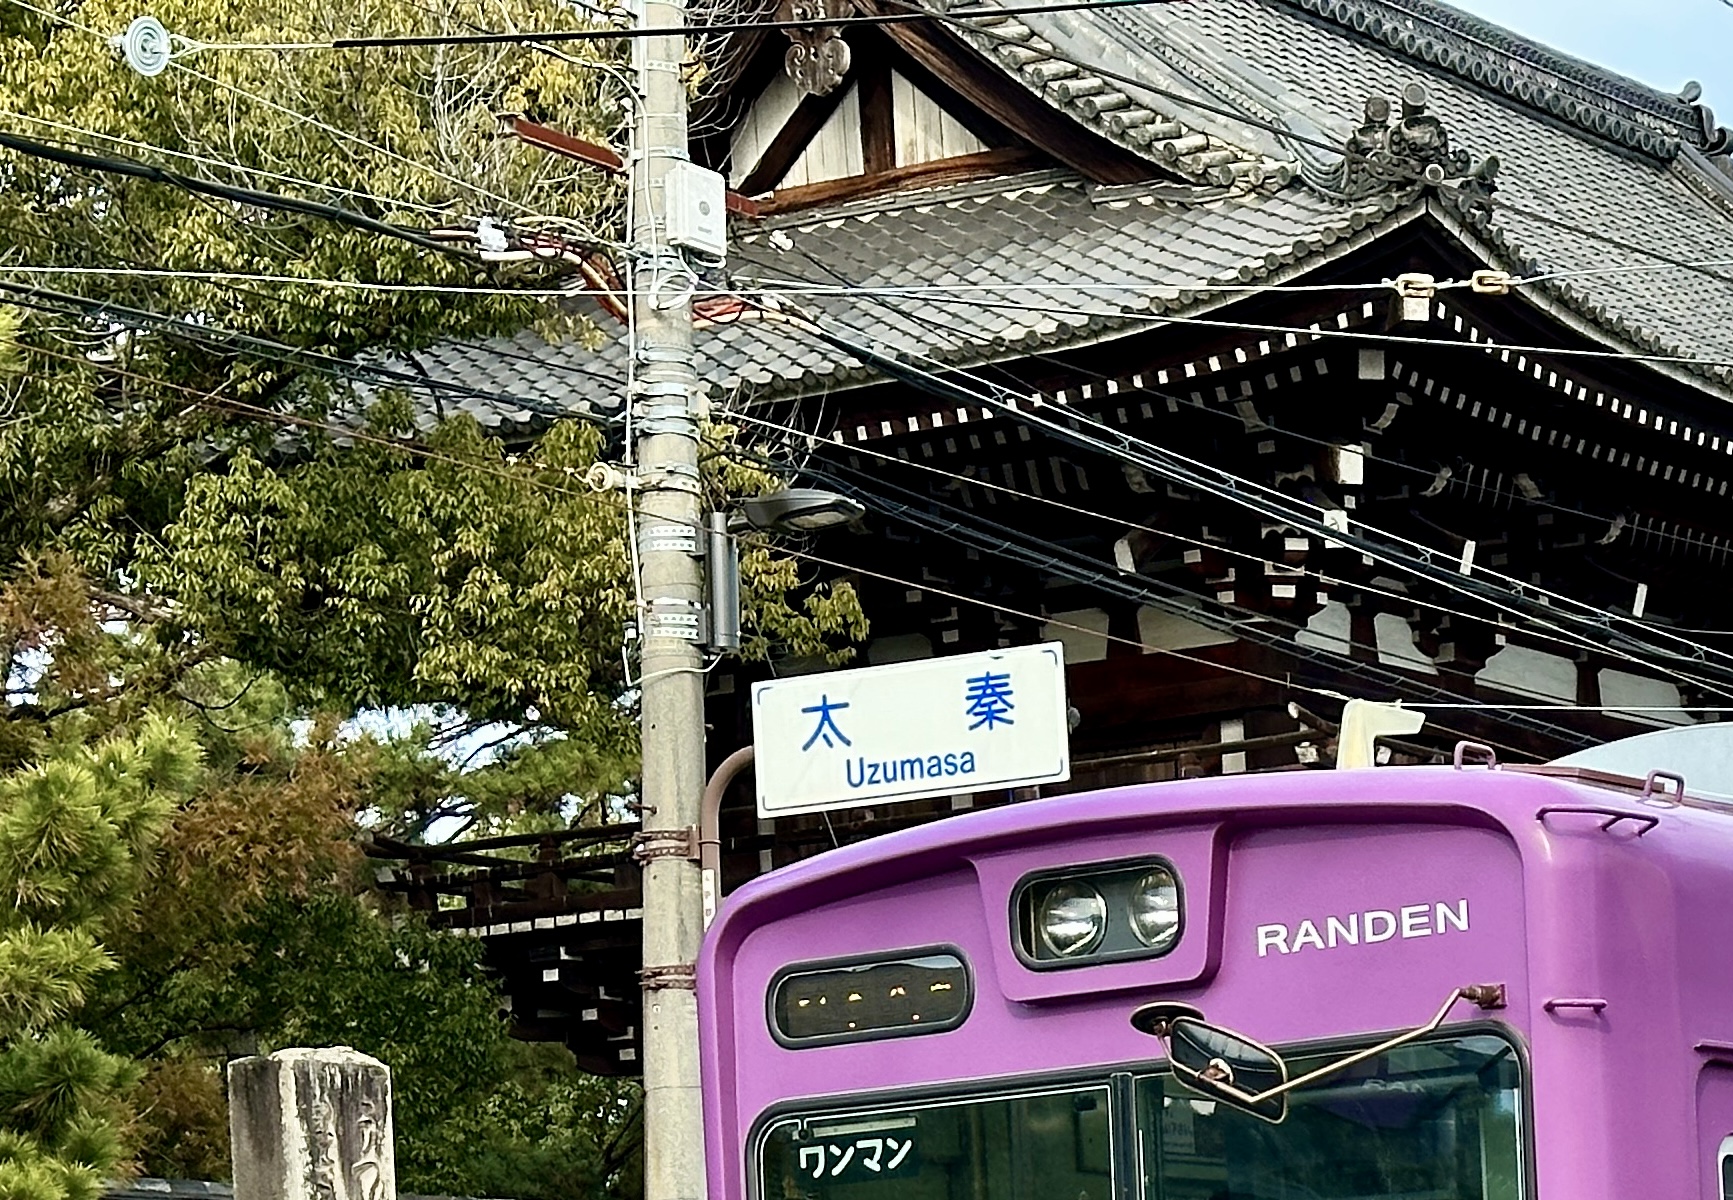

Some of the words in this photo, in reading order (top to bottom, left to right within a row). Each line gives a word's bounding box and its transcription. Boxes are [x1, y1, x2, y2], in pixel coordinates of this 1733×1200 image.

[845, 750, 976, 788] Uzumasa
[1256, 898, 1469, 957] RANDEN
[799, 1137, 912, 1178] ワンマン
